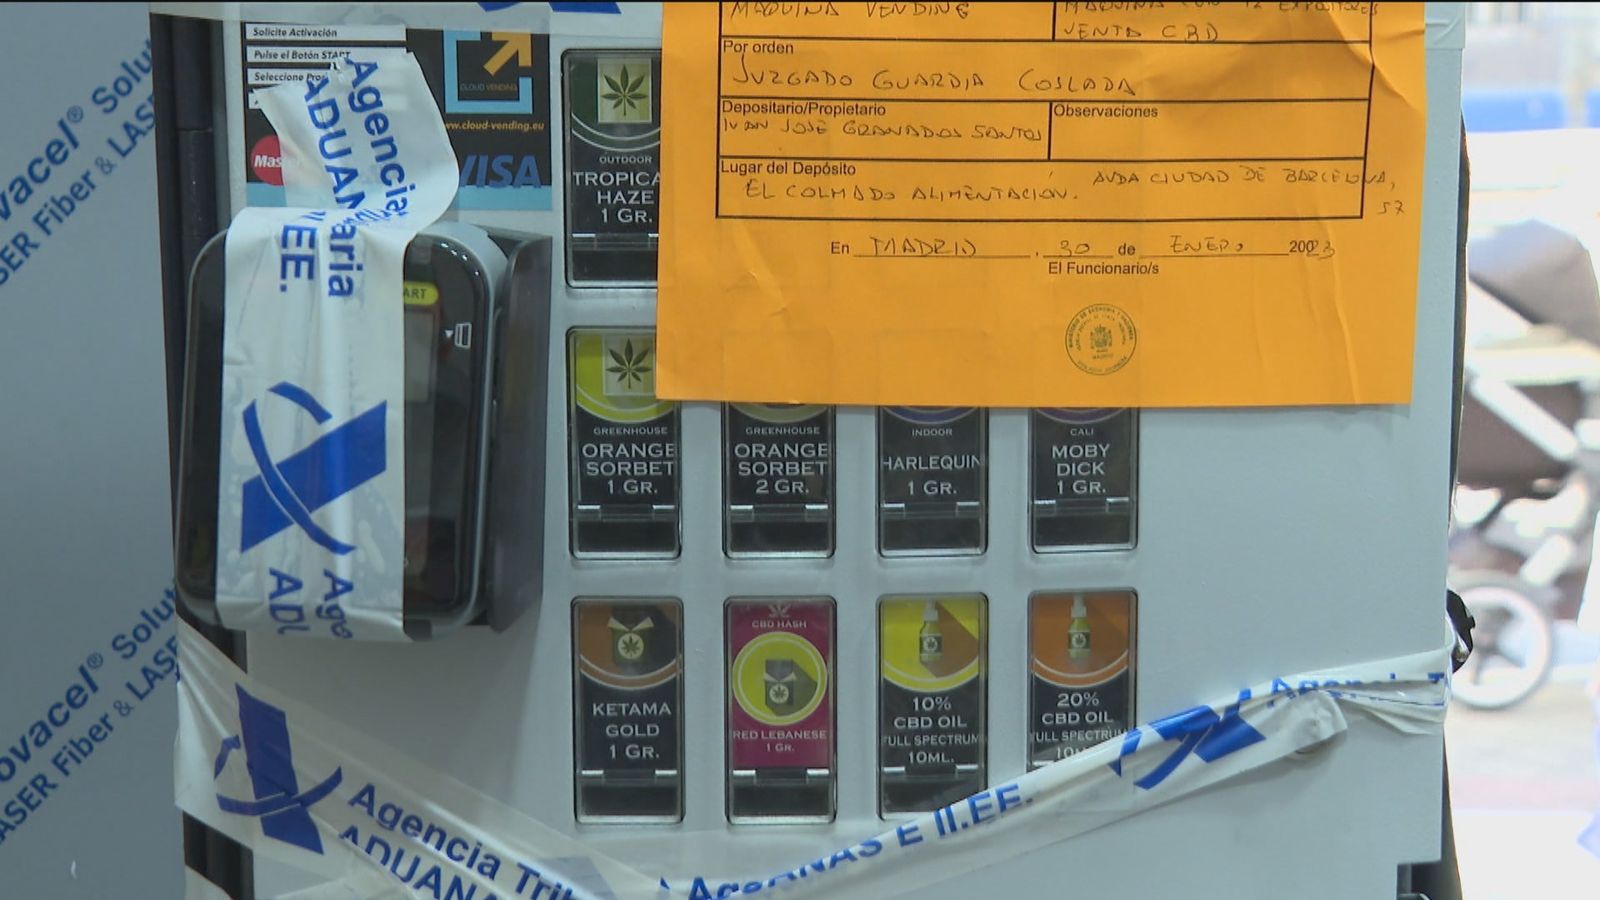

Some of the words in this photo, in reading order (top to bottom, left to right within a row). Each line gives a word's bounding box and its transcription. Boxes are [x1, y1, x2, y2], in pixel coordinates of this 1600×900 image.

[253, 27, 287, 36] Solicite
[289, 27, 337, 37] Activación
[1064, 22, 1141, 40] VENTA
[1162, 22, 1218, 43] CBD
[723, 40, 748, 53] Por
[752, 41, 794, 54] orden
[254, 50, 279, 59] Pulse
[281, 50, 290, 59] el
[291, 50, 319, 60] Botón
[92, 39, 152, 114] Solu
[255, 71, 304, 81] Seleccione
[733, 54, 852, 86] JUZGADO
[872, 69, 984, 91] GUARDIA
[1018, 69, 1135, 96] COSLADA
[461, 83, 485, 91] CLOUD
[722, 101, 887, 117] Depositario/Propietario
[1053, 104, 1158, 118] Observaciones
[971, 124, 1042, 141] SANTOS
[33, 169, 96, 236] Fiber
[95, 156, 117, 176] &
[107, 94, 155, 158] LAS
[600, 156, 652, 164] OUTDOOR
[721, 161, 762, 176] Lugar
[767, 162, 788, 175] del
[793, 162, 856, 177] Depósito
[1150, 170, 1229, 184] CIUDAD
[745, 178, 776, 198] EL
[786, 184, 896, 201] COLMADO
[597, 190, 654, 204] HAZE
[602, 208, 608, 223] 1
[831, 242, 849, 254] En
[1118, 244, 1136, 256] de
[1049, 262, 1062, 275] El
[1067, 262, 1160, 276] Funcionario/s
[593, 427, 668, 435] GREENHOUSE
[745, 427, 820, 435] GREENHOUSE
[912, 428, 953, 437] INDOOR
[1070, 428, 1094, 436] CALI
[582, 443, 674, 458] ORANGE
[734, 443, 828, 458] ORANGE
[1052, 443, 1110, 459] MOBY
[586, 461, 674, 476] SORBET
[738, 461, 828, 476] SORBET
[1057, 462, 1105, 476] DICK
[608, 480, 614, 494] 1
[755, 480, 769, 494] 2
[908, 481, 914, 495] 1
[1057, 481, 1063, 495] 1
[752, 620, 774, 628] CBD
[777, 620, 807, 628] HASH
[912, 696, 952, 711] 10%
[1057, 692, 1100, 707] 20%
[593, 703, 671, 716] KETAMA
[894, 717, 933, 729] CBD
[937, 715, 967, 728] OIL
[1042, 713, 1080, 725] CBD
[1085, 711, 1113, 723] OIL
[606, 724, 660, 736] GOLD
[733, 730, 758, 740] RED
[761, 730, 827, 740] LEBANESE
[52, 711, 115, 777] Fiber
[113, 700, 134, 717] &
[609, 746, 616, 758] 1
[766, 743, 770, 751] 1
[909, 751, 954, 763] 10ML.
[348, 783, 501, 880] Agencia
[896, 823, 923, 847] E
[339, 825, 500, 900] ADUAN
